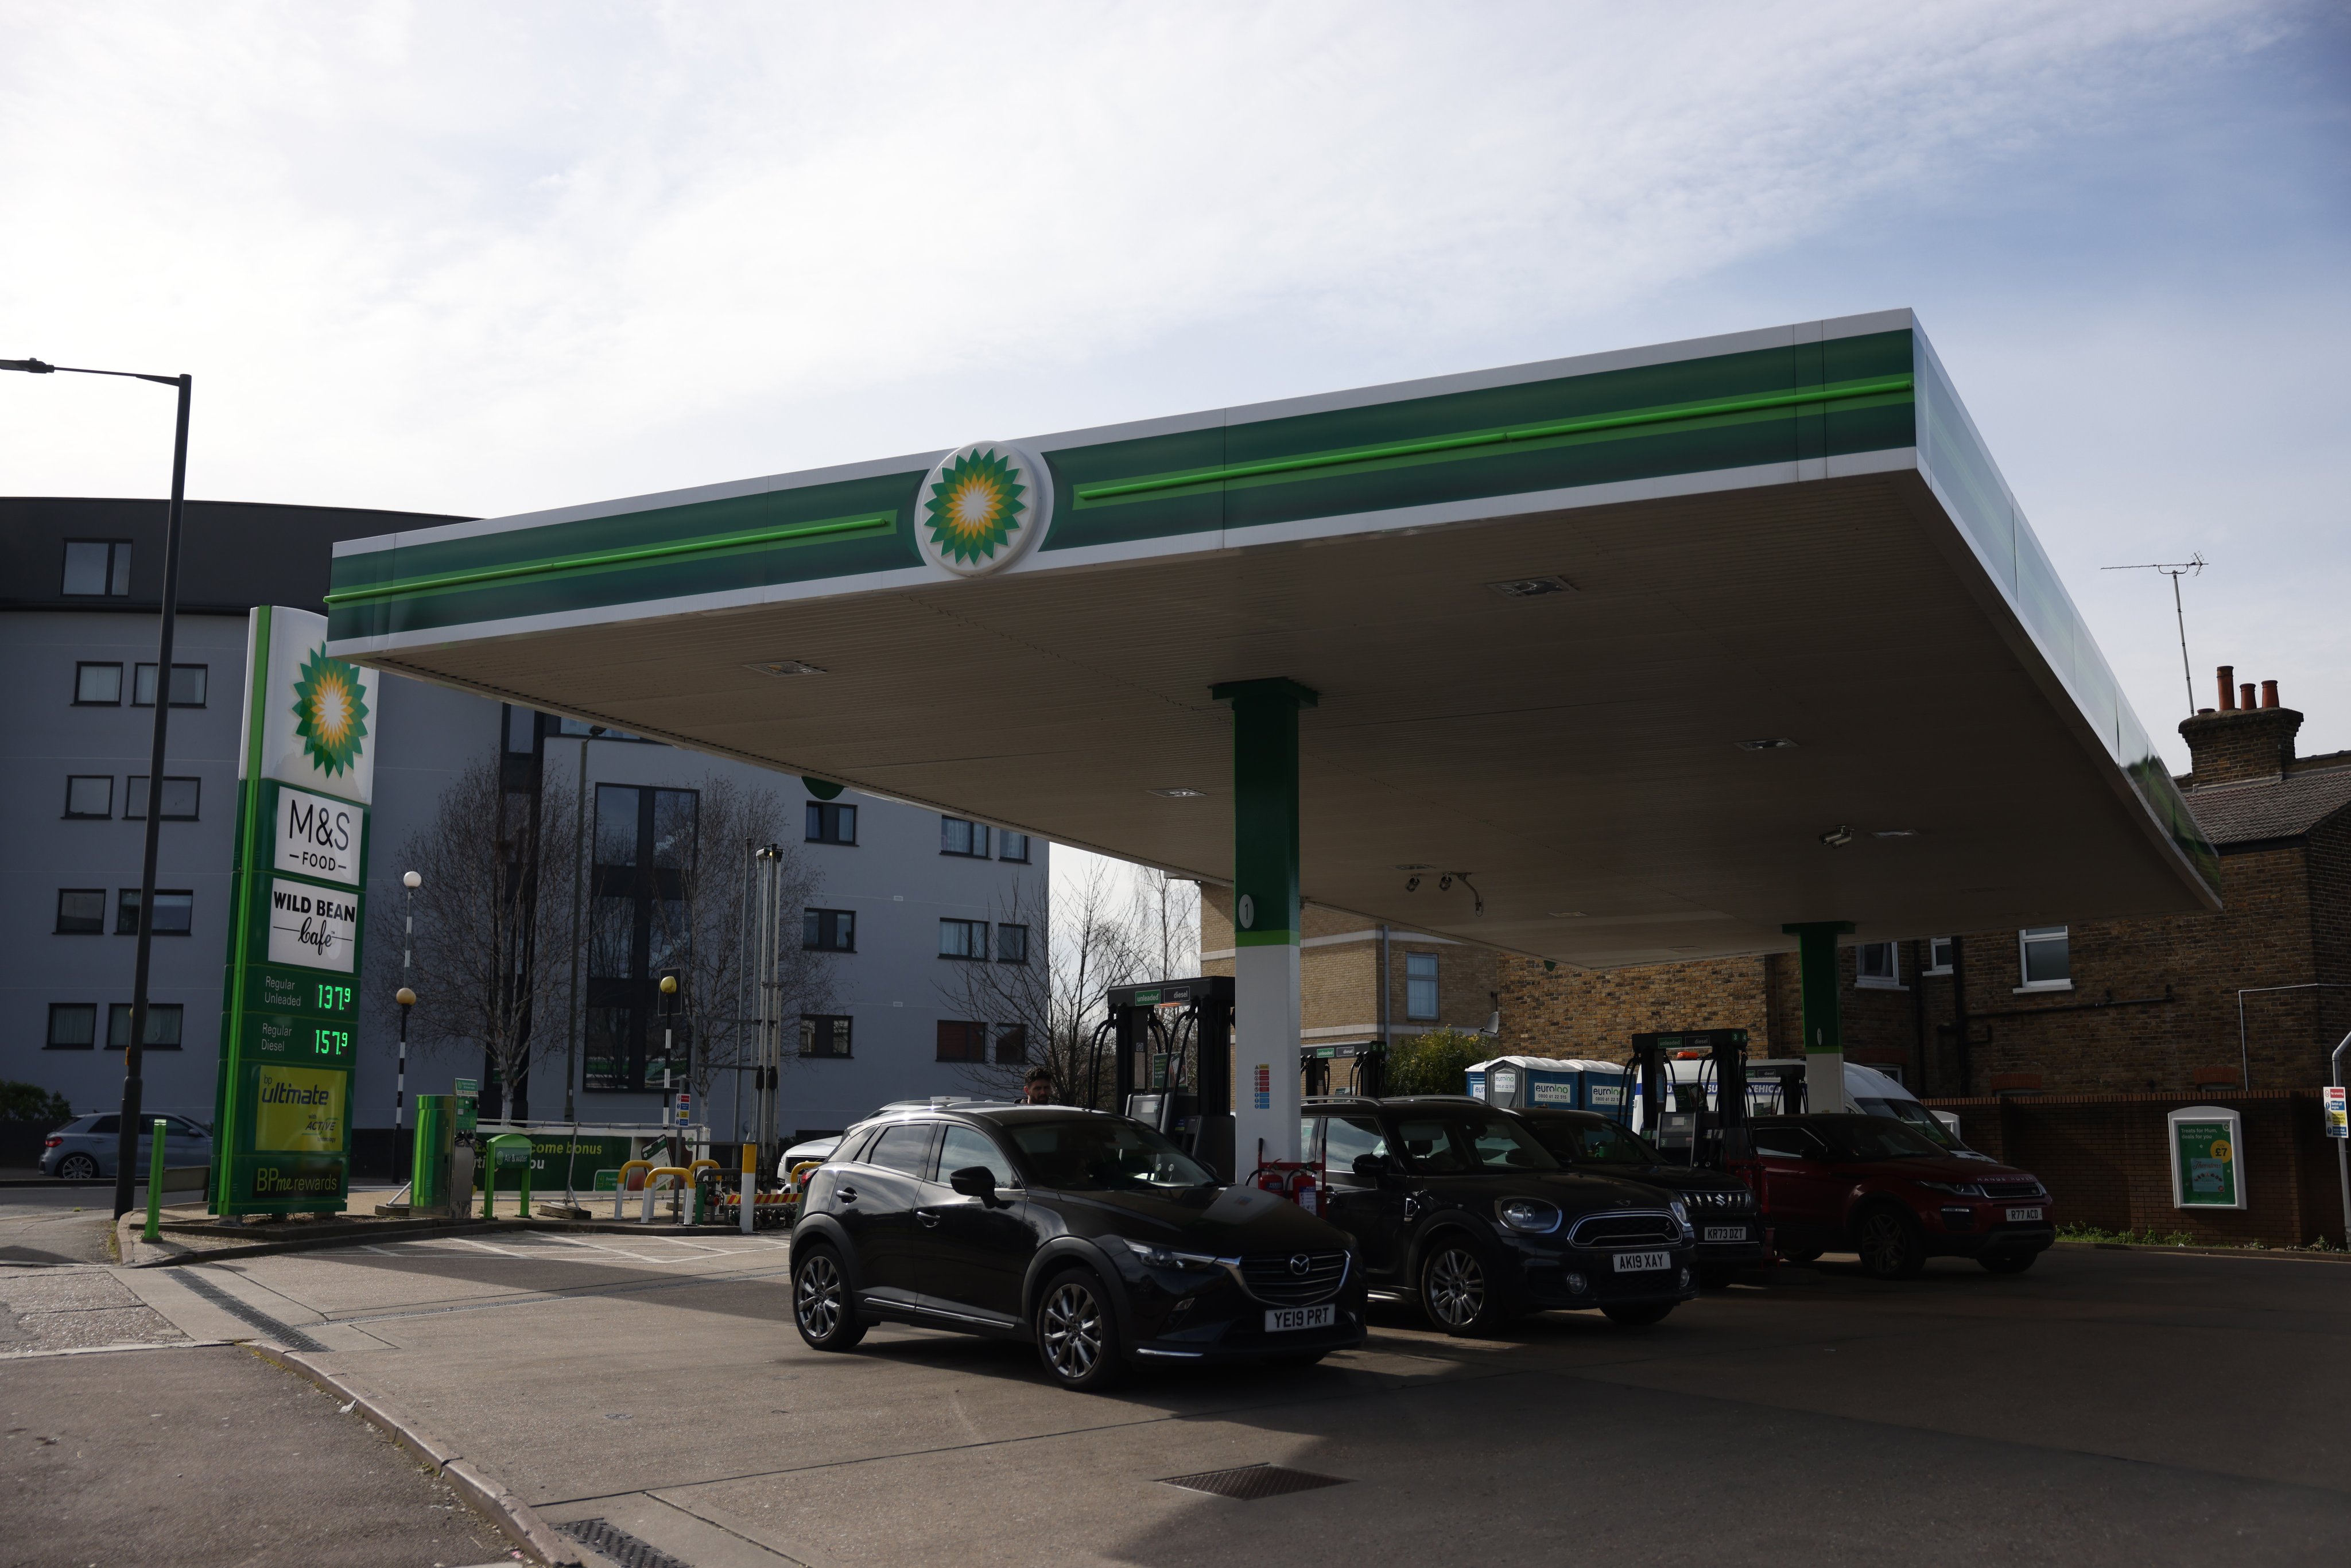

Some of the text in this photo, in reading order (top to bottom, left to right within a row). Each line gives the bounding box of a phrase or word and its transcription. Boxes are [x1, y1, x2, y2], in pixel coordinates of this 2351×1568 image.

[289, 799, 350, 851] M&S
[302, 852, 335, 871] FOOD
[274, 891, 355, 922] WILD BEAN
[1244, 903, 1248, 920] 1
[266, 976, 295, 991] Regular
[265, 992, 301, 1006] Unleaded
[1137, 990, 1188, 1002] unleaded diesel
[262, 1023, 292, 1038] Regular
[261, 1039, 285, 1051] Diesel
[264, 1074, 272, 1086] bp
[262, 1082, 329, 1105] ultimate
[1535, 1084, 1568, 1093] euroloo
[305, 1121, 336, 1131] ACTIVE
[532, 1141, 602, 1154] come bonus
[2215, 1148, 2228, 1156] £7
[511, 1154, 515, 1162] &
[530, 1159, 545, 1169] ou
[2193, 1161, 2221, 1170] Thorntons
[294, 1174, 337, 1190] rewards
[2011, 1209, 2038, 1219] R77 ACD
[1708, 1228, 1743, 1239] KR73 DZT
[1620, 1254, 1663, 1269] AK19 XAY
[1274, 1307, 1329, 1328] YE19 PRT
